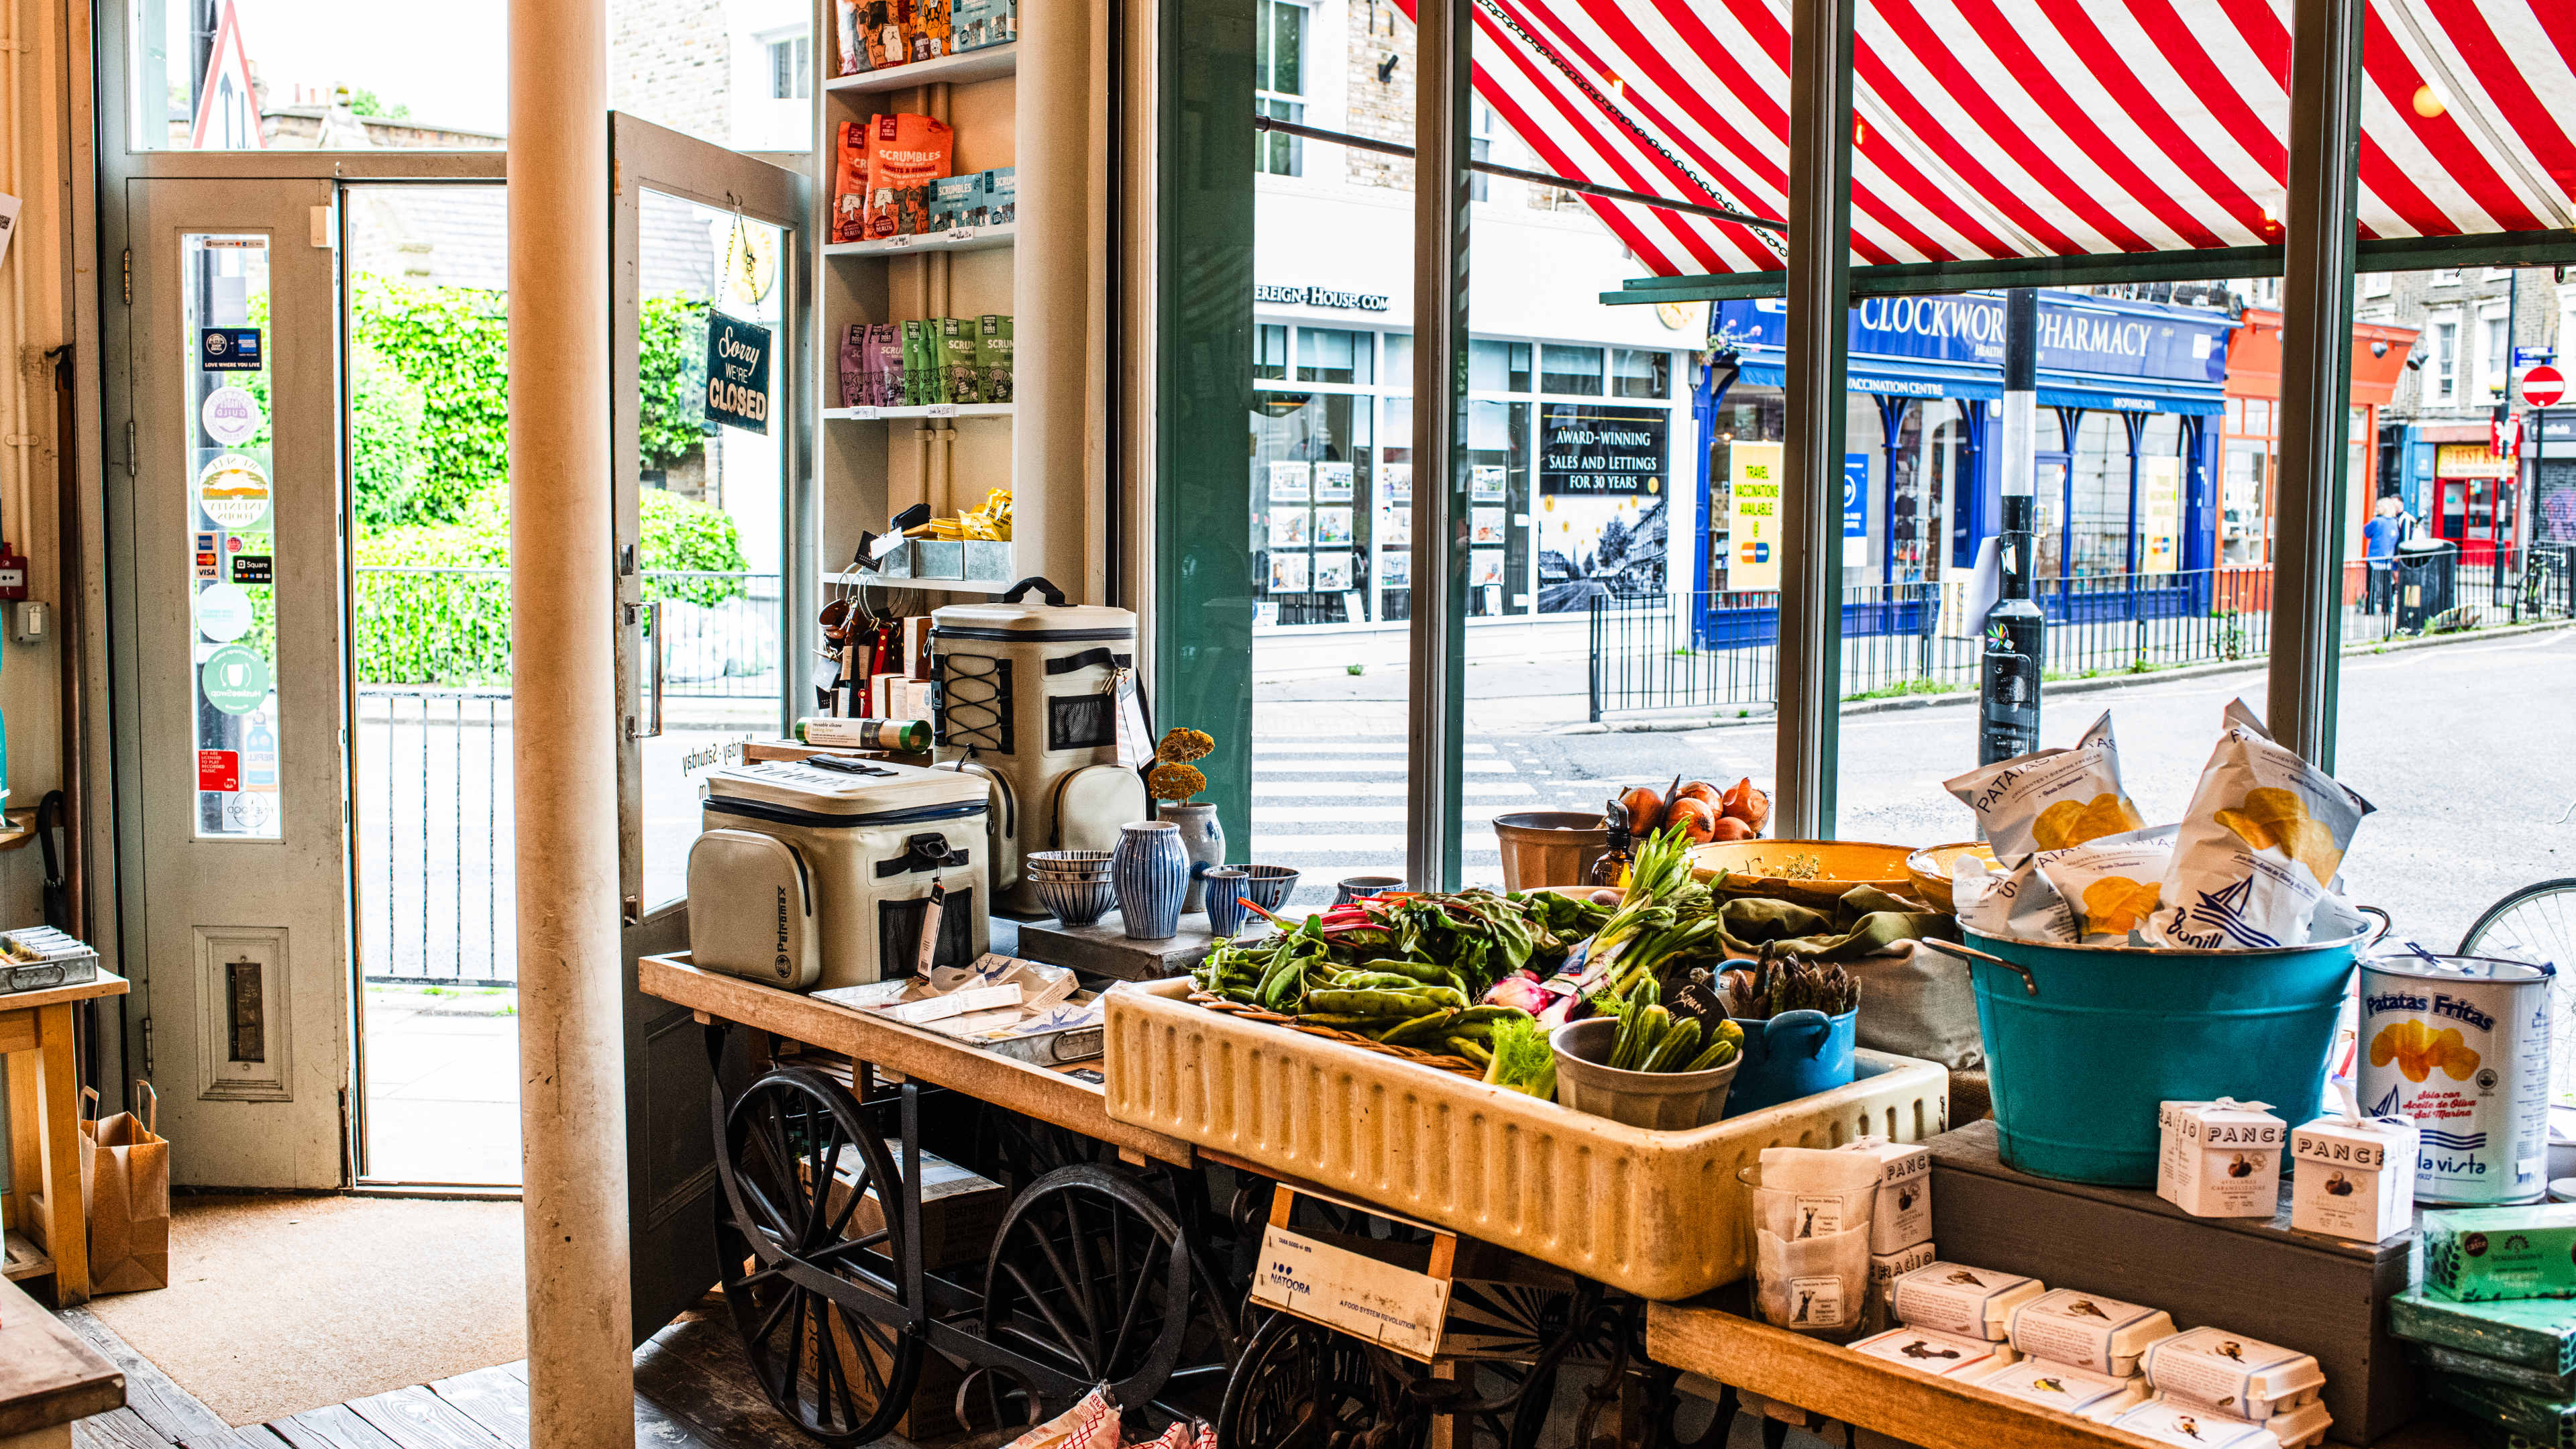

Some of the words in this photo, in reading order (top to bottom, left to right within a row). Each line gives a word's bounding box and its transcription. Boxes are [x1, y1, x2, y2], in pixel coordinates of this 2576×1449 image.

[879, 149, 941, 162] SCRUMBLES
[883, 164, 904, 173] ADULTS
[912, 165, 936, 173] SENIORS
[938, 182, 971, 196] SCRUMBLES
[1860, 297, 2005, 343] CLOCKWOR
[718, 325, 760, 376] Sorry
[881, 346, 903, 354] SCRU
[1975, 343, 2004, 358] HEALTH
[725, 362, 748, 384] WE'RE
[1847, 378, 1908, 394] VACCINATION
[1909, 382, 1943, 396] CENTRE
[708, 377, 766, 421] CLOSED
[1556, 431, 1651, 446] AWARD-WINNING
[1548, 455, 1578, 471] SALES
[1582, 455, 1605, 470] AND
[1609, 455, 1657, 471] LETTINGS
[2455, 448, 2478, 464] BEST
[1746, 466, 1768, 479] TRAVEL
[1570, 475, 1590, 489] FOR
[1593, 475, 1605, 488] 30
[1607, 475, 1638, 490] YEARS
[1735, 484, 1778, 498] VACCINATIONS
[1739, 502, 1772, 515] AVAILABLE
[247, 561, 268, 569] Square
[776, 885, 788, 953] Petromax
[2366, 992, 2429, 1019] Patatas
[2432, 993, 2496, 1034] Fritas
[2402, 1100, 2434, 1108] Aceite
[2436, 1100, 2449, 1108] de
[2450, 1099, 2477, 1108] Oliva
[2414, 1111, 2431, 1120] Sal
[2432, 1110, 2471, 1120] Marina
[2418, 1148, 2432, 1170] la
[2437, 1152, 2486, 1174] vista
[1279, 1237, 1288, 1245] TARA
[1271, 1273, 1310, 1296] NATOORA
[1344, 1301, 1359, 1311] FOOD
[1359, 1305, 1381, 1319] SYSTEM
[1381, 1313, 1415, 1330] REVOLUTION
